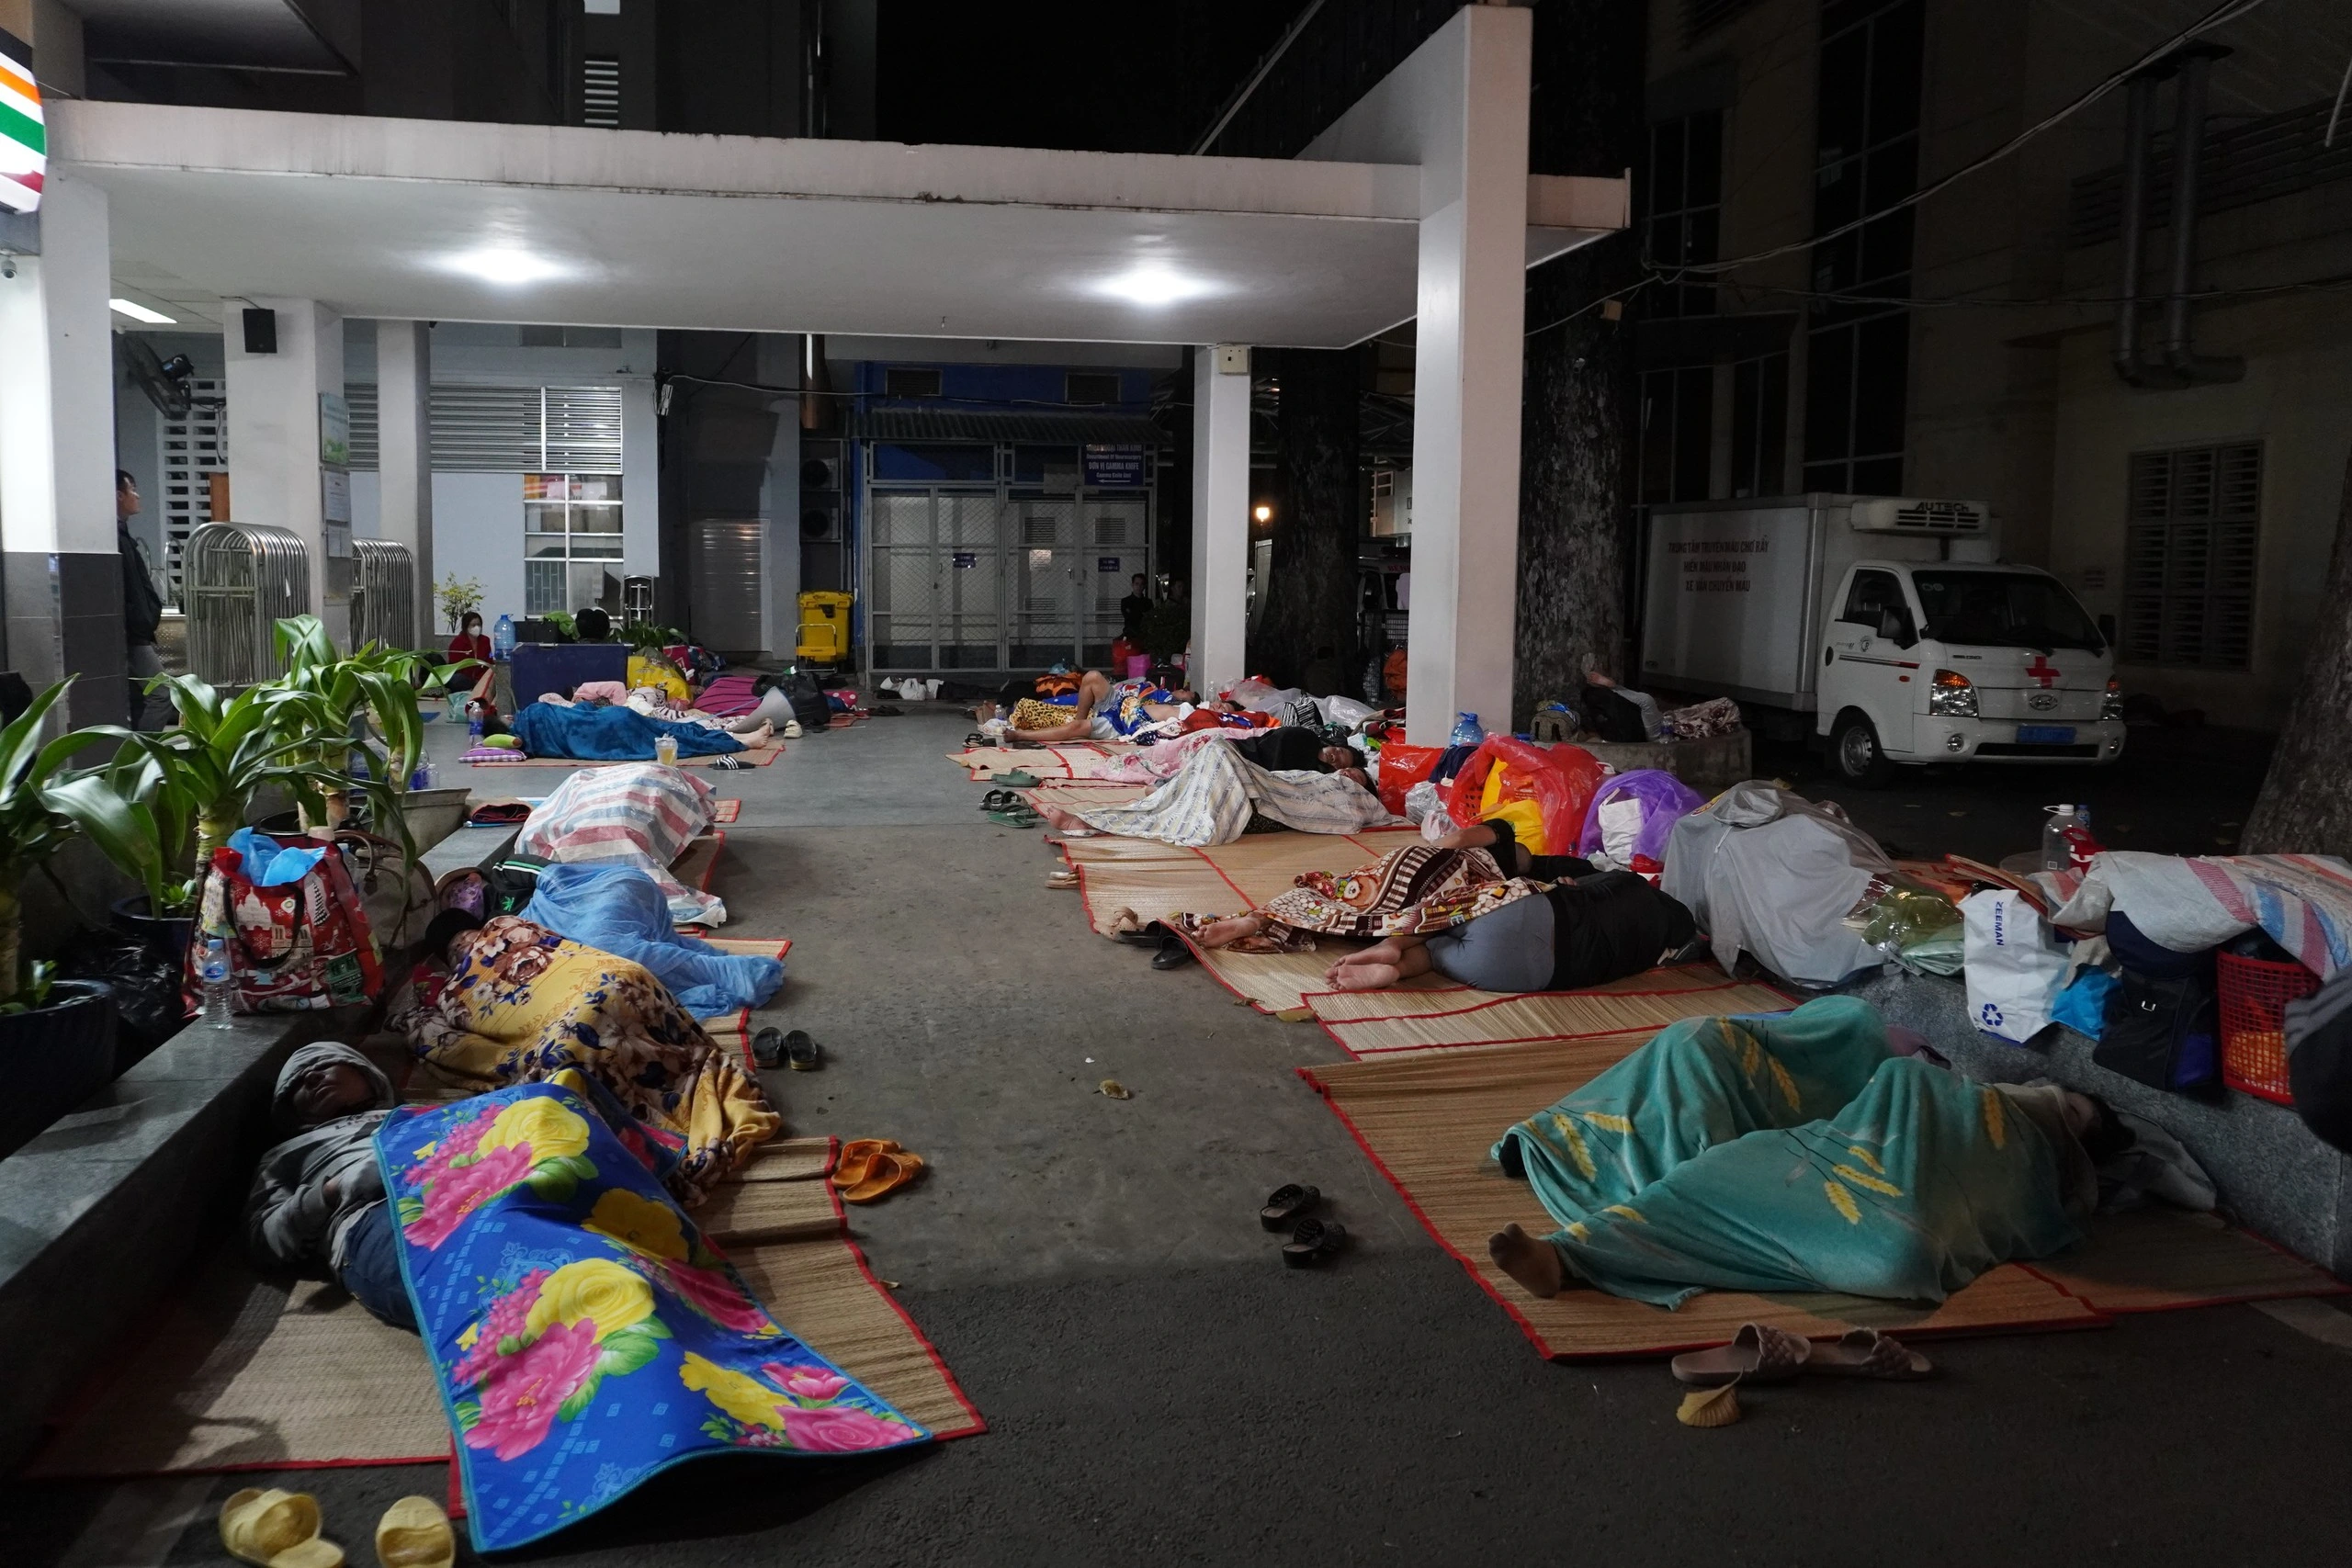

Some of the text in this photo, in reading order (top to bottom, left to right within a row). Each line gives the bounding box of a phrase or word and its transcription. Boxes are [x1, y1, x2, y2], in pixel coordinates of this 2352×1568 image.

[1668, 542, 1687, 553] TRUNG
[1686, 580, 1693, 592] XE
[1995, 901, 2005, 946] ZEEMAN
